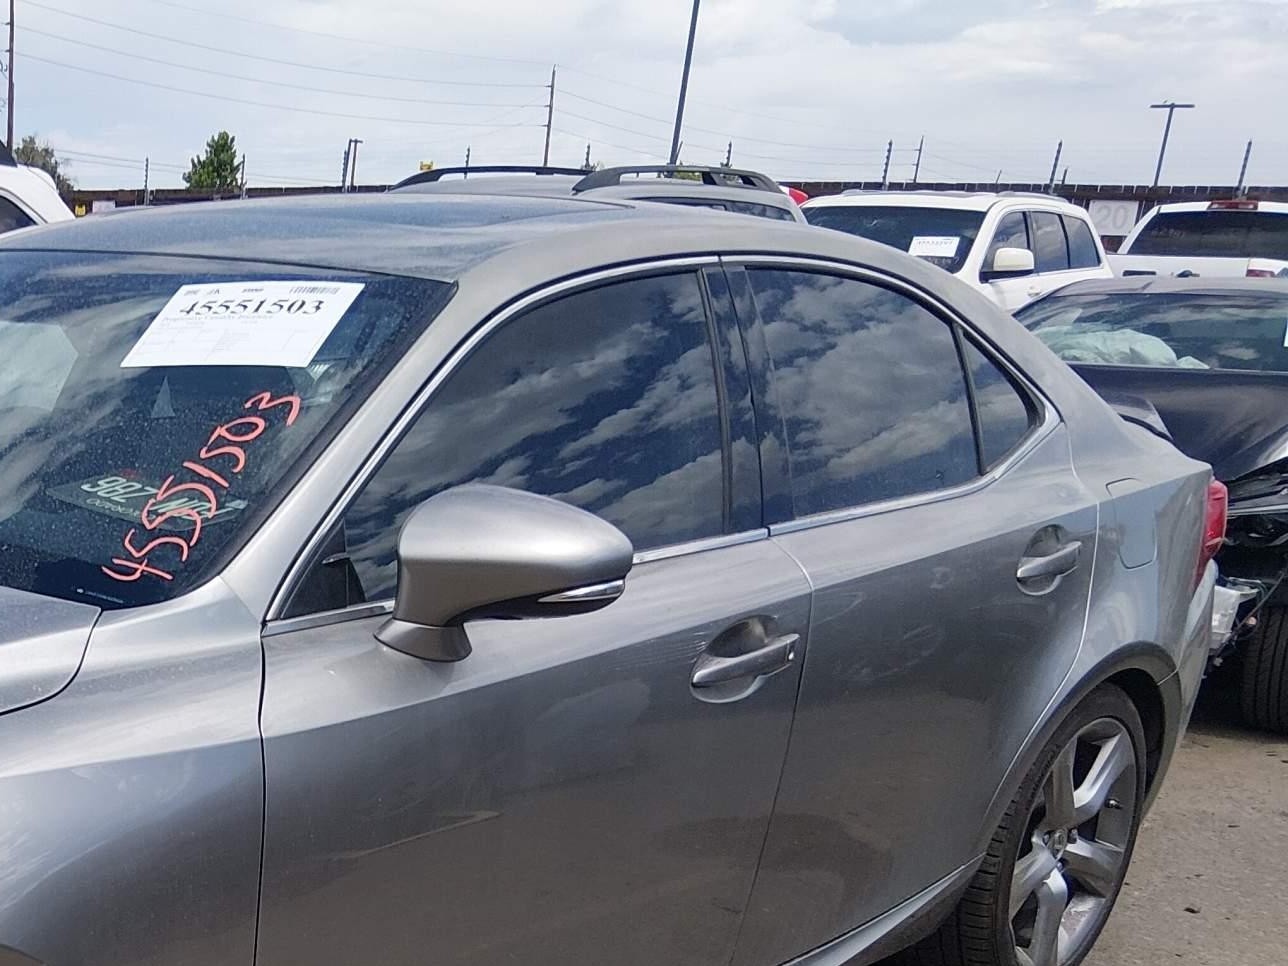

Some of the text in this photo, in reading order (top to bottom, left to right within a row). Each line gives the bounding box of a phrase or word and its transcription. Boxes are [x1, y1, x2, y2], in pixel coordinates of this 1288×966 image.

[1096, 204, 1127, 230] 20
[179, 299, 324, 315] 45551503
[101, 391, 302, 582] 45551503
